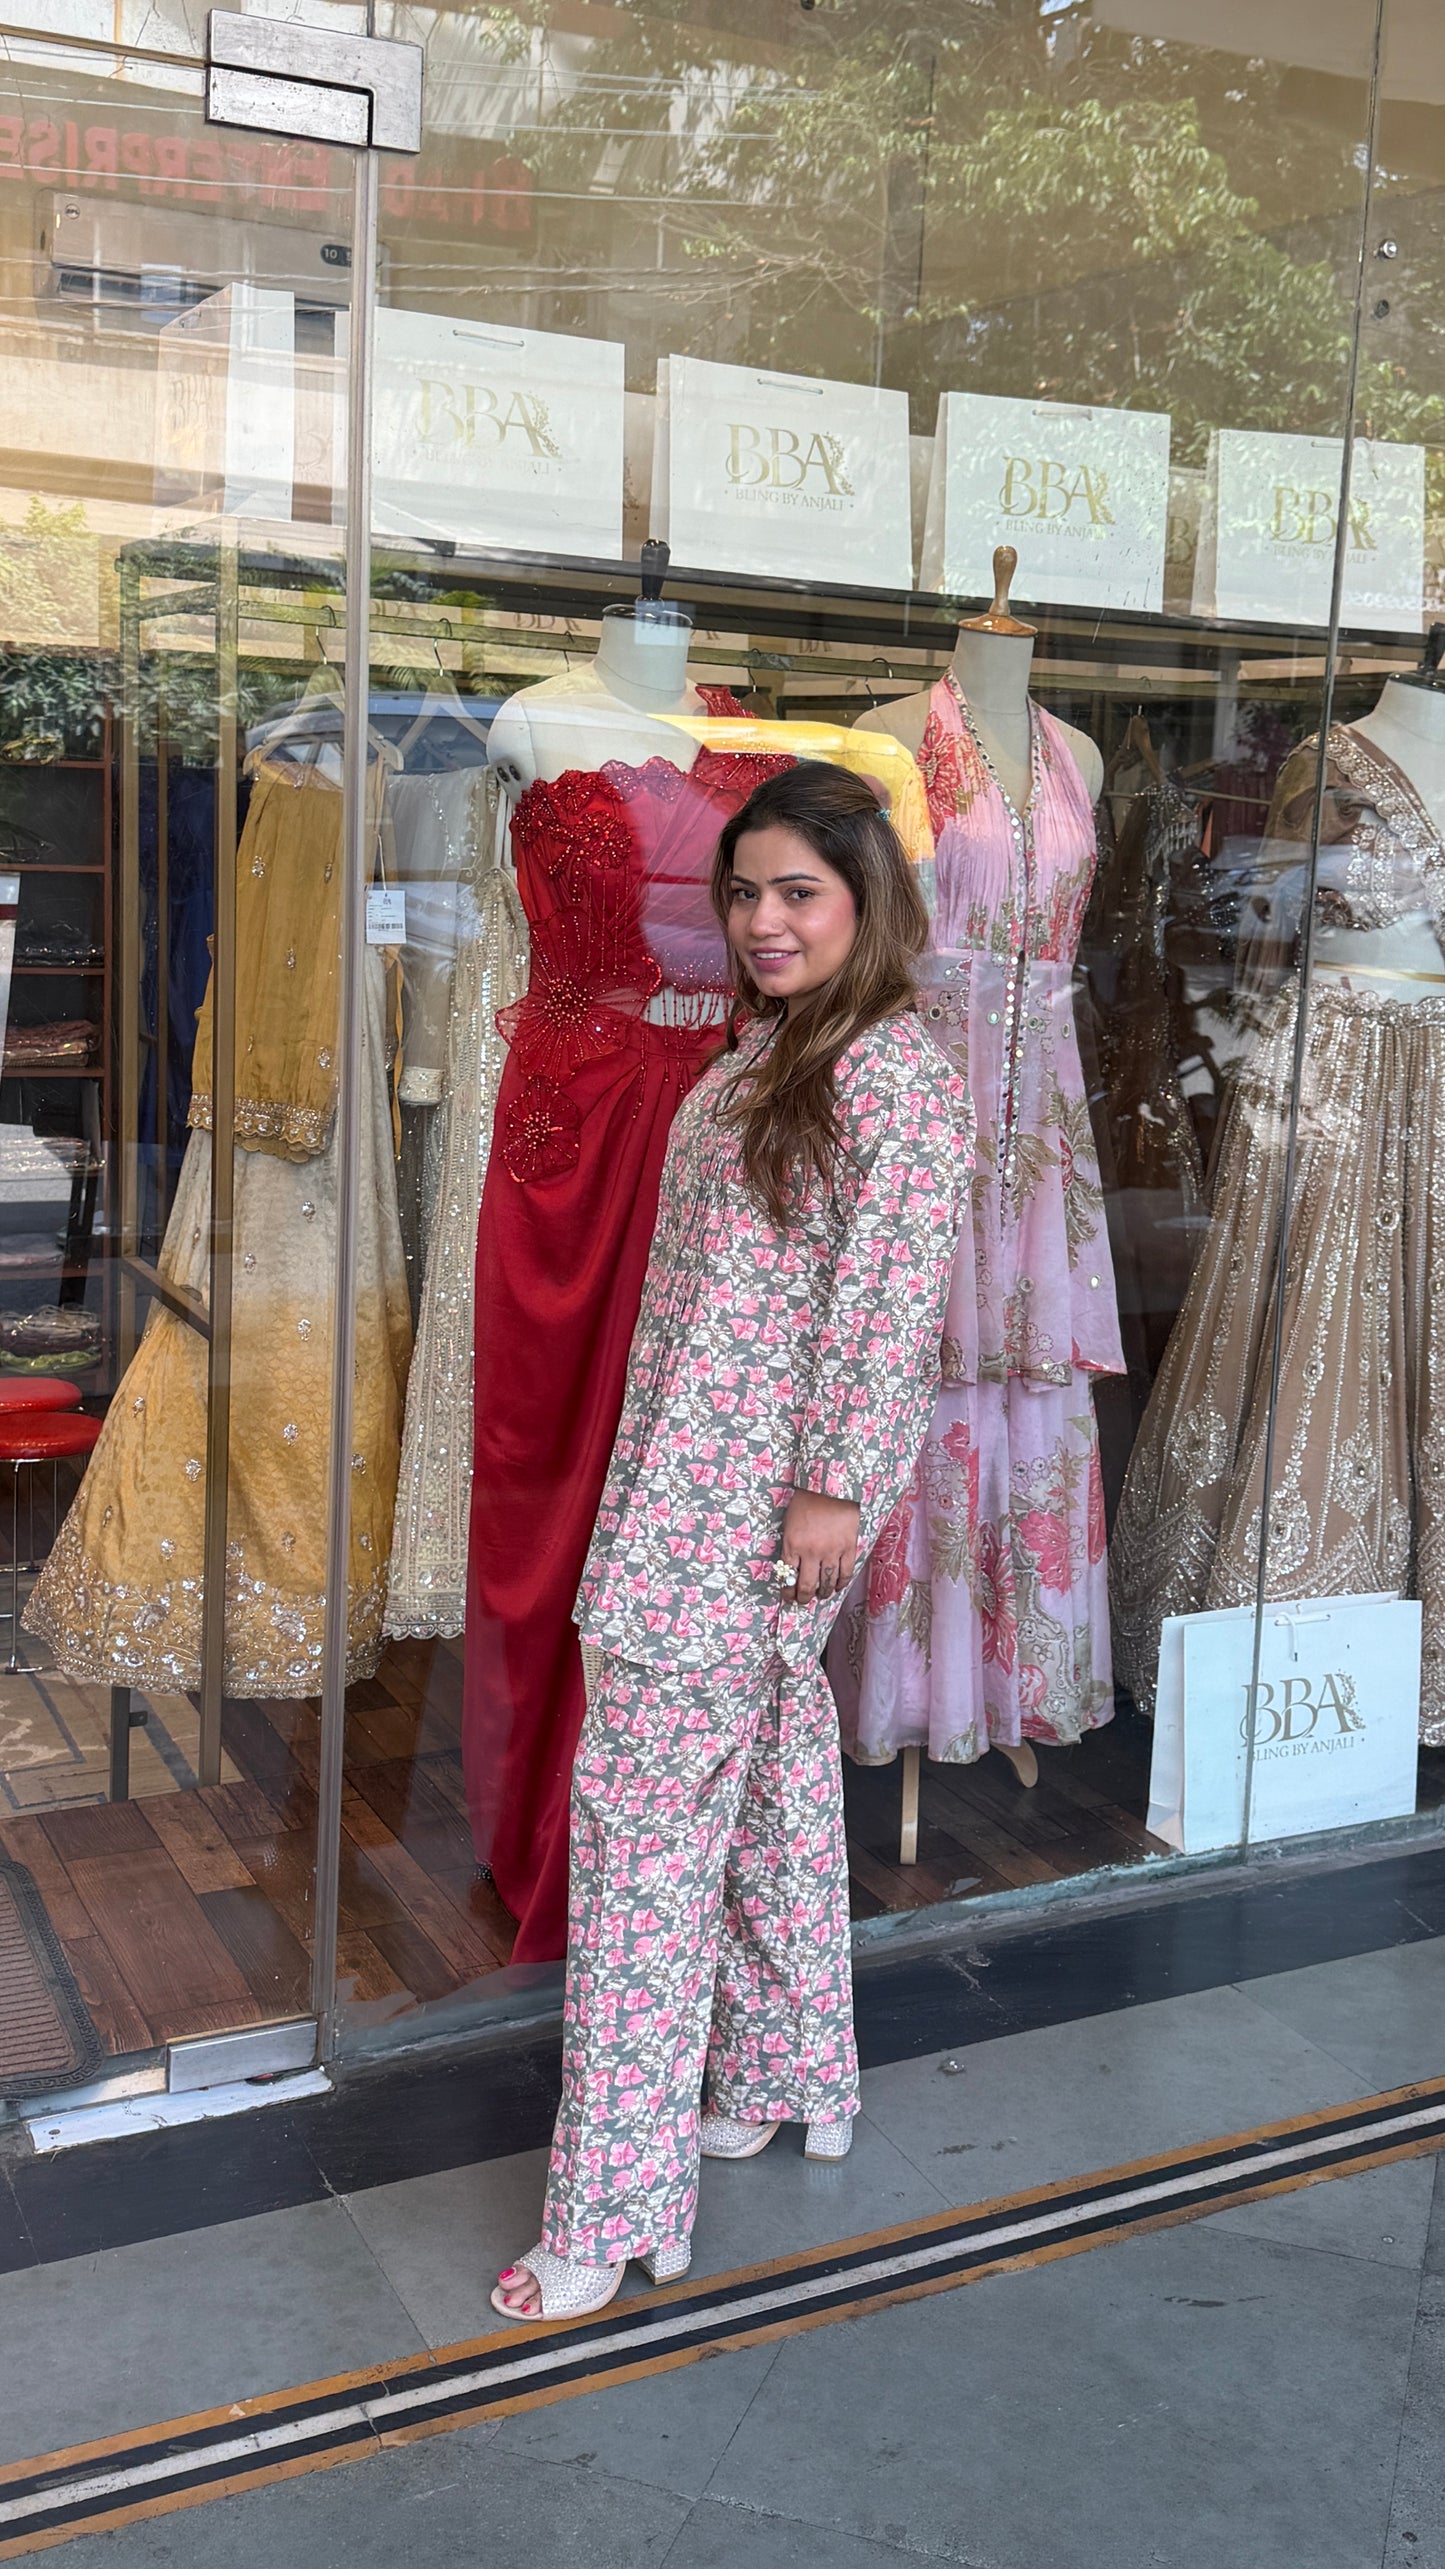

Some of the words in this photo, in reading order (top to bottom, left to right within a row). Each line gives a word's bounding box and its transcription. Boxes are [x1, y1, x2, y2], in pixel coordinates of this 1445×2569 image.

[415, 378, 564, 459] BBA
[725, 423, 856, 496] BBA
[999, 456, 1117, 526] BBA
[735, 488, 780, 504] BLING
[782, 492, 800, 506] BY
[800, 495, 844, 512] ANJALI
[1006, 519, 1045, 535] BLING
[1047, 523, 1064, 536] BY
[1269, 486, 1378, 551] BBA
[1240, 1668, 1367, 1748] BBA
[1252, 1745, 1290, 1762] LING
[1292, 1742, 1309, 1757] BY
[1310, 1735, 1355, 1755] ANJALI
